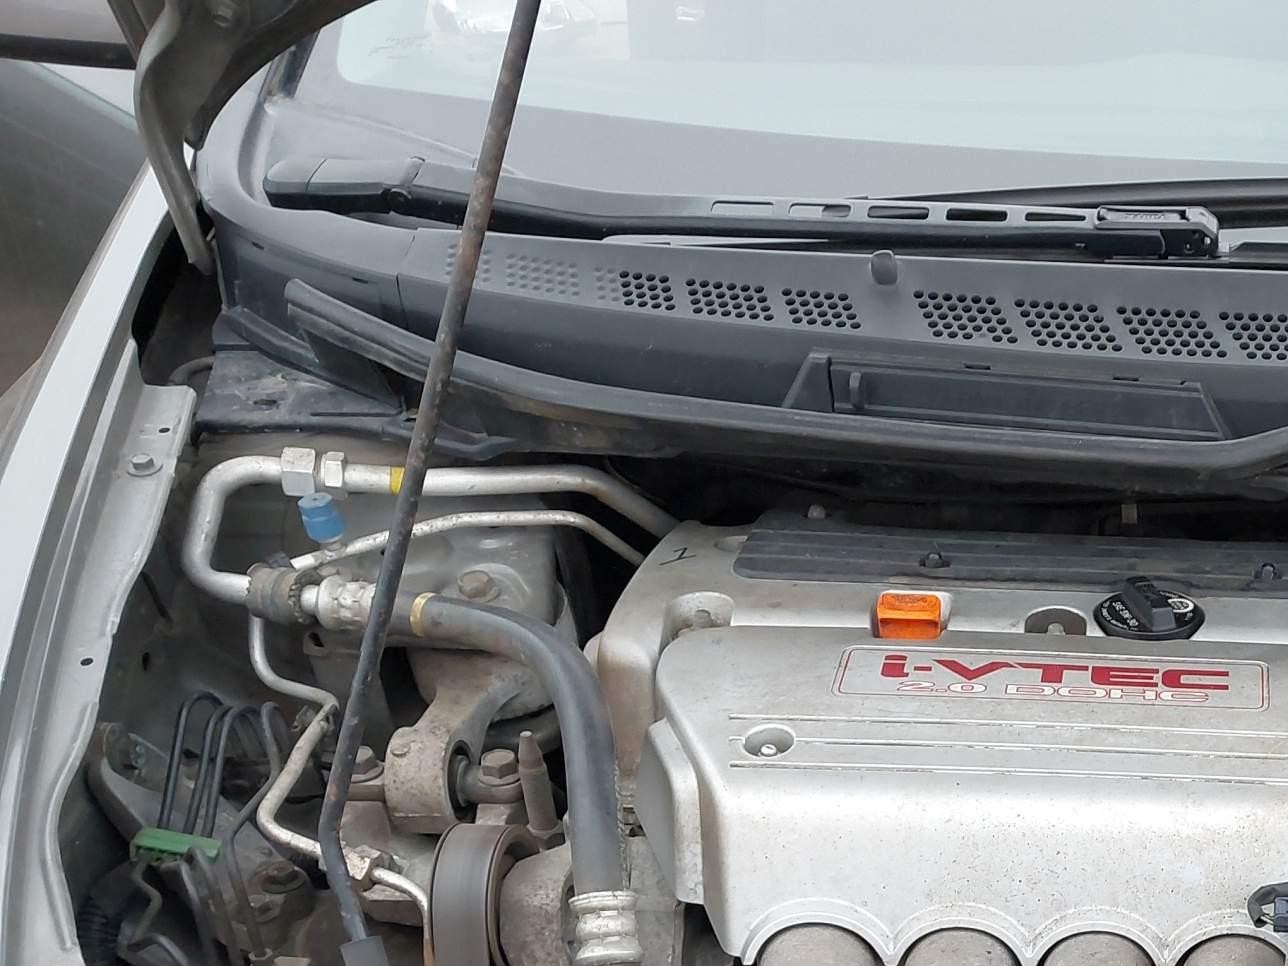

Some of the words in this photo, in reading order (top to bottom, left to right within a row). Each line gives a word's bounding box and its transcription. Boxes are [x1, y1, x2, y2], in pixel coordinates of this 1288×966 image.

[881, 654, 1230, 691] i-VTEC
[896, 681, 988, 695] 2.0
[1005, 683, 1209, 702] DOHC
